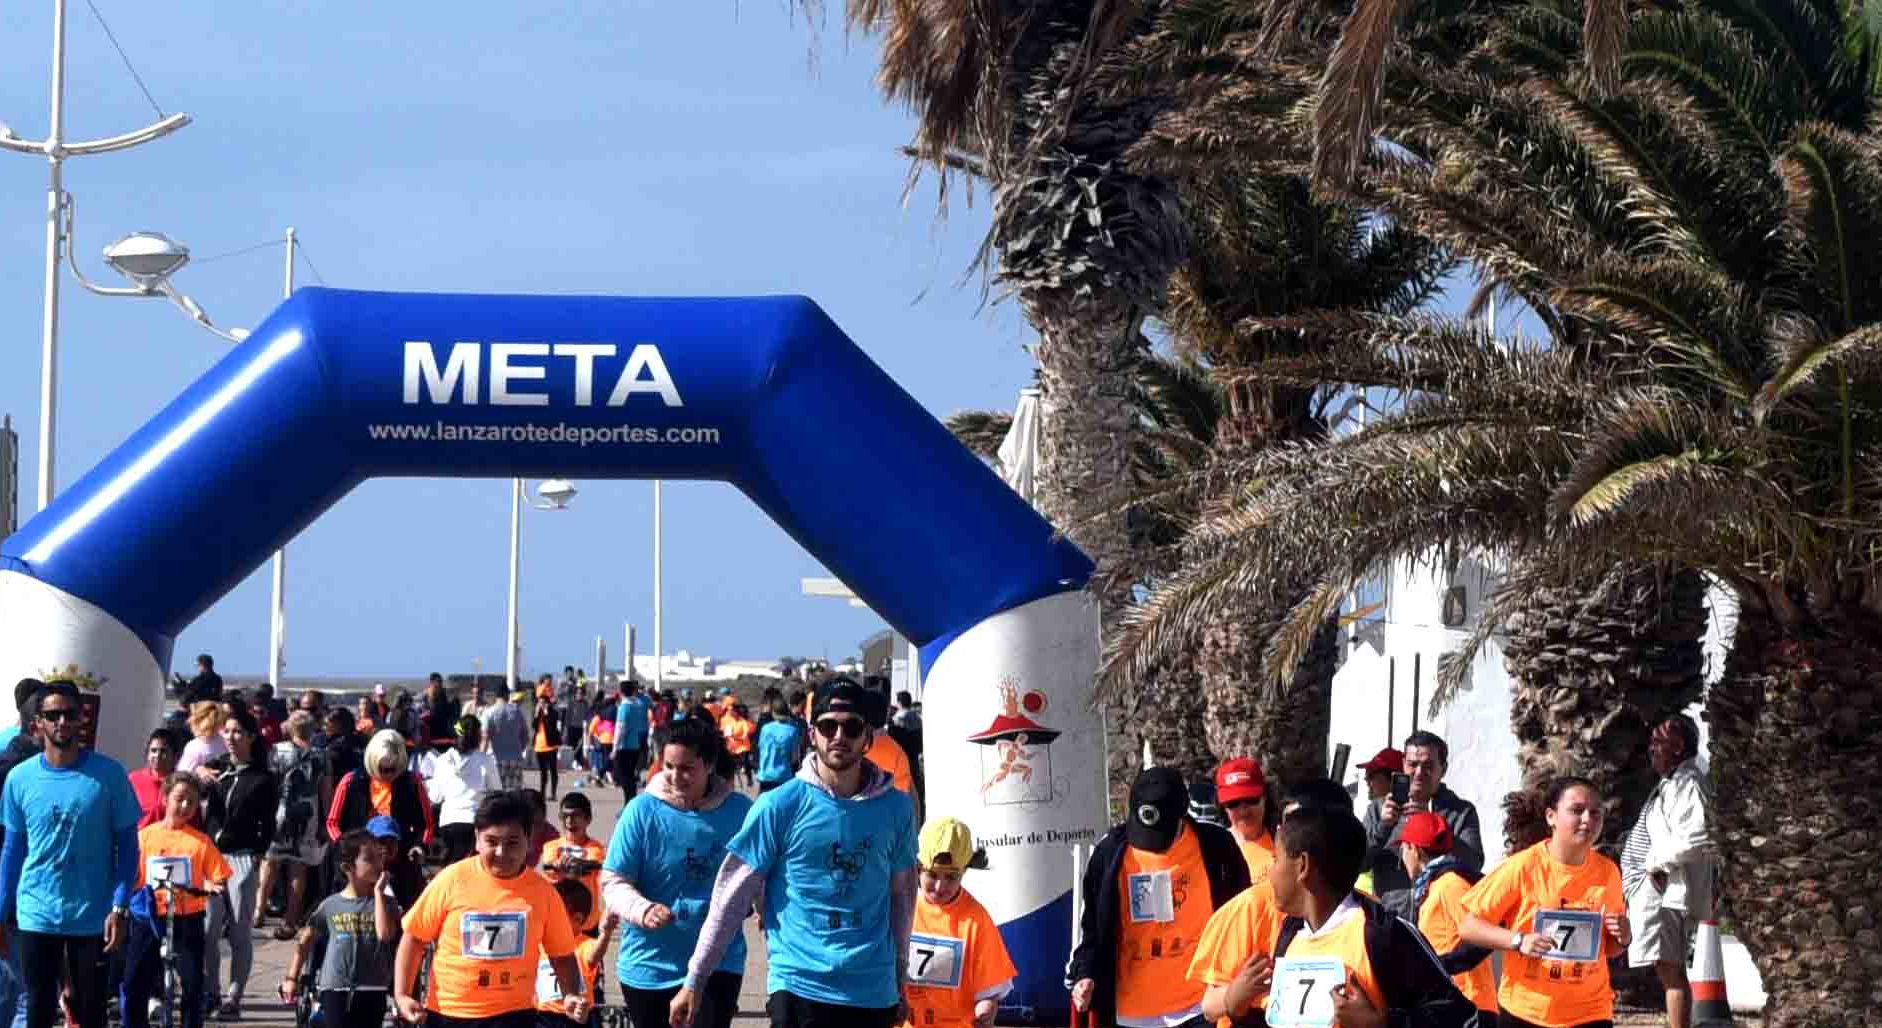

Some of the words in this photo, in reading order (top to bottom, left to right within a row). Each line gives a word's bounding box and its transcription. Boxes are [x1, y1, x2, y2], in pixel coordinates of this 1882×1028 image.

[402, 341, 685, 406] META
[368, 419, 720, 446] www.lanzarotedeportes.com
[1026, 831, 1043, 845] de
[162, 864, 175, 881] 7
[484, 925, 501, 951] 7
[1558, 924, 1576, 952] 7
[916, 948, 935, 977] 7
[1298, 978, 1316, 1015] 7
